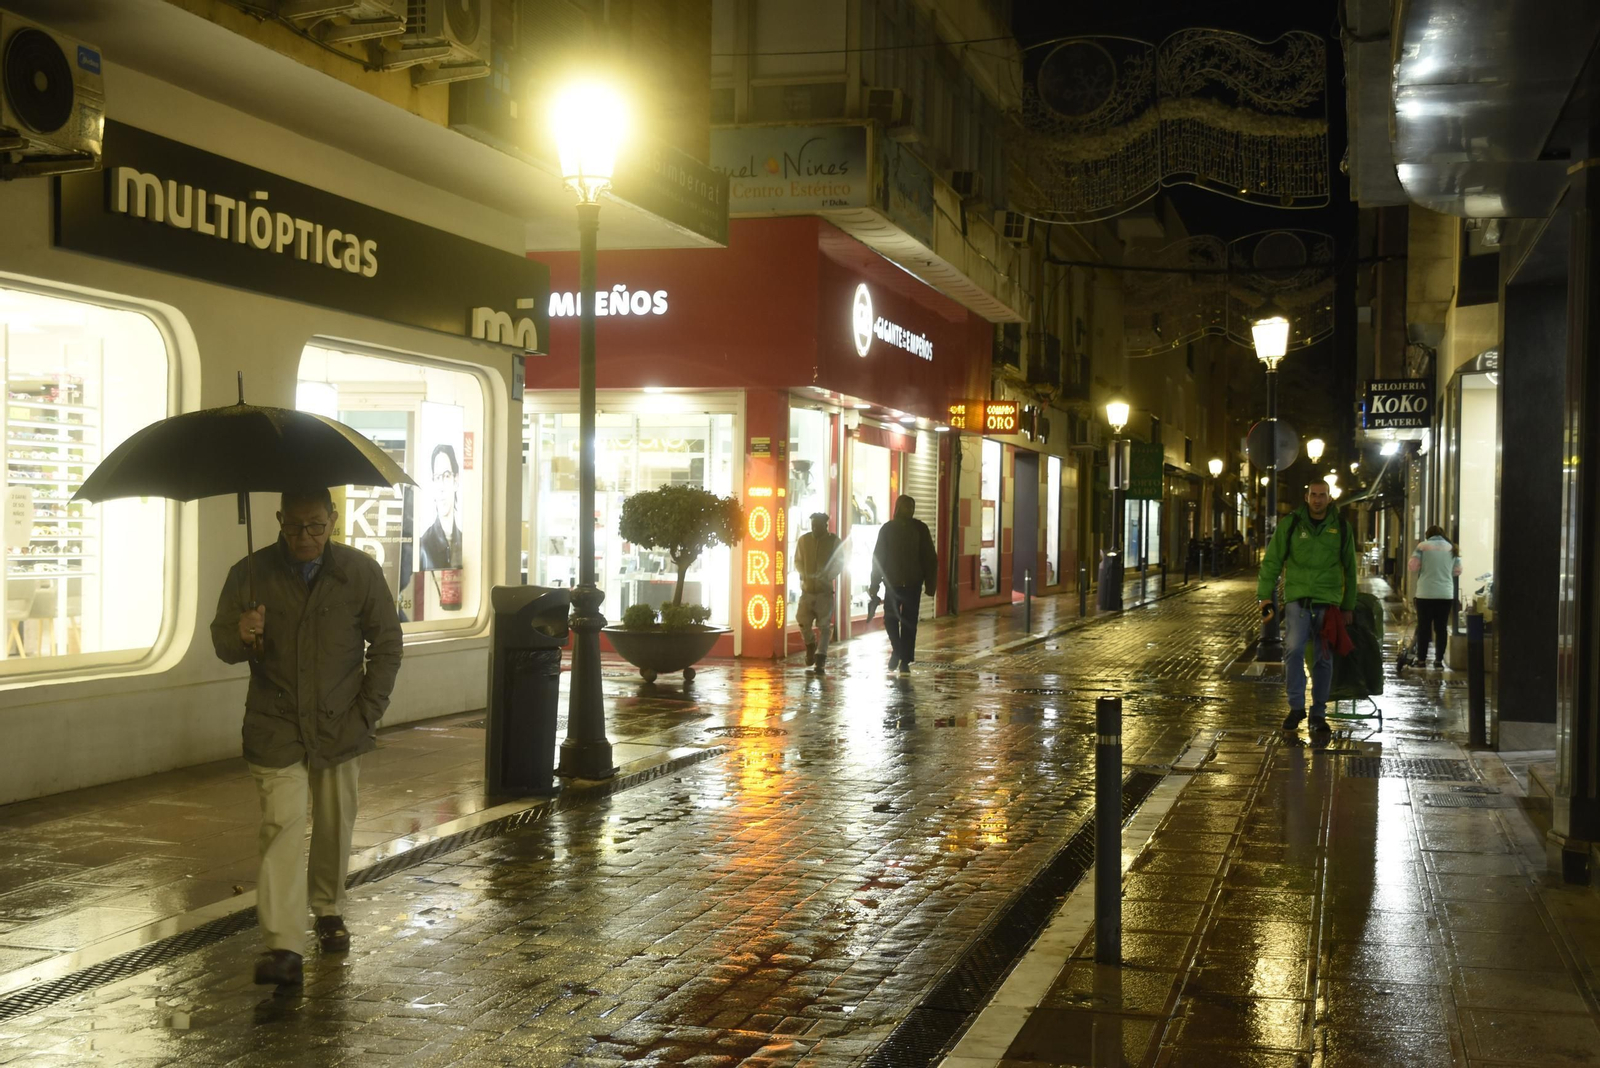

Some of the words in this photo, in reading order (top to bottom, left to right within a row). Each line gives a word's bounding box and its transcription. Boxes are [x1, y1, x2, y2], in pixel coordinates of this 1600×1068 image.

[784, 137, 850, 180] Nines
[654, 150, 720, 205] Gimbernat
[732, 183, 784, 199] Centro
[790, 181, 851, 198] Estético
[548, 283, 669, 317] MEÑOS
[906, 331, 933, 361] EMPEÑOS
[1371, 382, 1426, 391] RELOJERIA
[1370, 394, 1428, 414] KOKO
[986, 416, 1015, 430] ORO
[1375, 418, 1423, 427] PLATERIA
[747, 506, 771, 629] ORO
